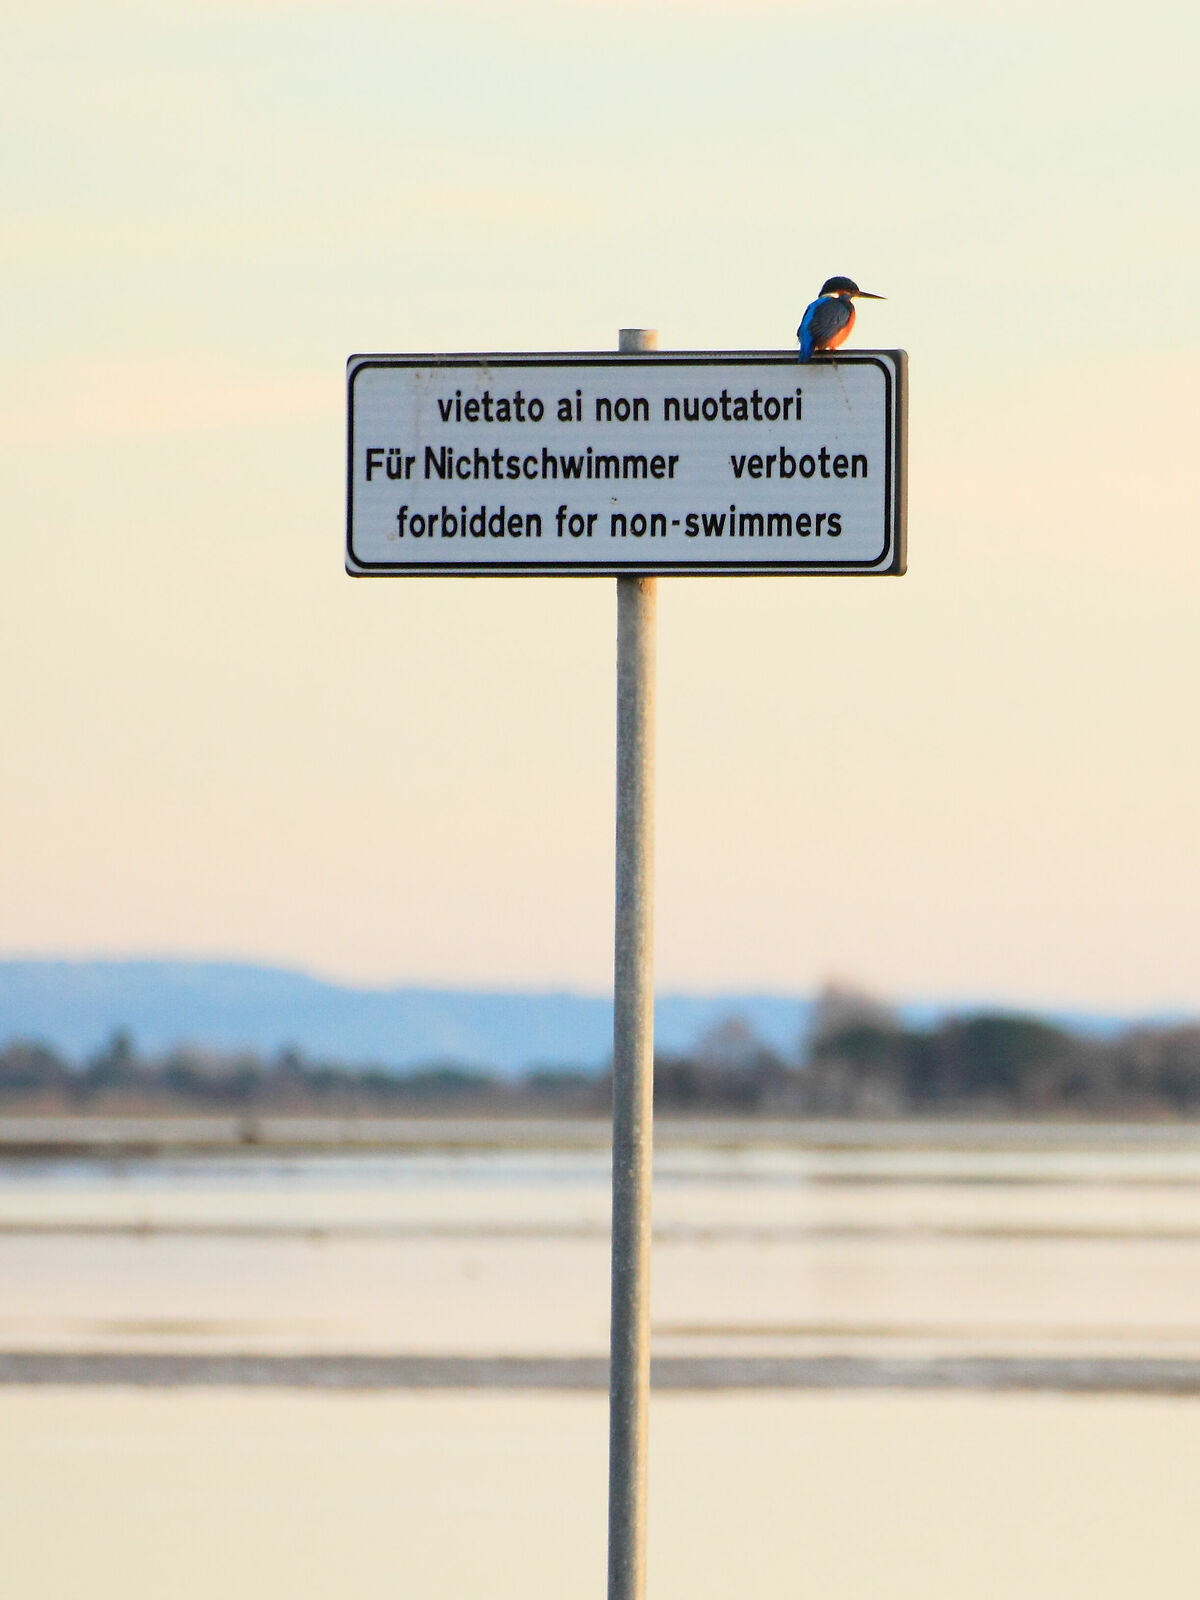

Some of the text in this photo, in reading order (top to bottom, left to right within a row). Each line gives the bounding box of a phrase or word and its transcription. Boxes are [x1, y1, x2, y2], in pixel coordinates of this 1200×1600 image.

[437, 387, 803, 423] vietato ai non nuotatori
[365, 445, 868, 482] Für Nichtschwimmer verboten
[396, 504, 842, 538] forbidden for non-swimmers
